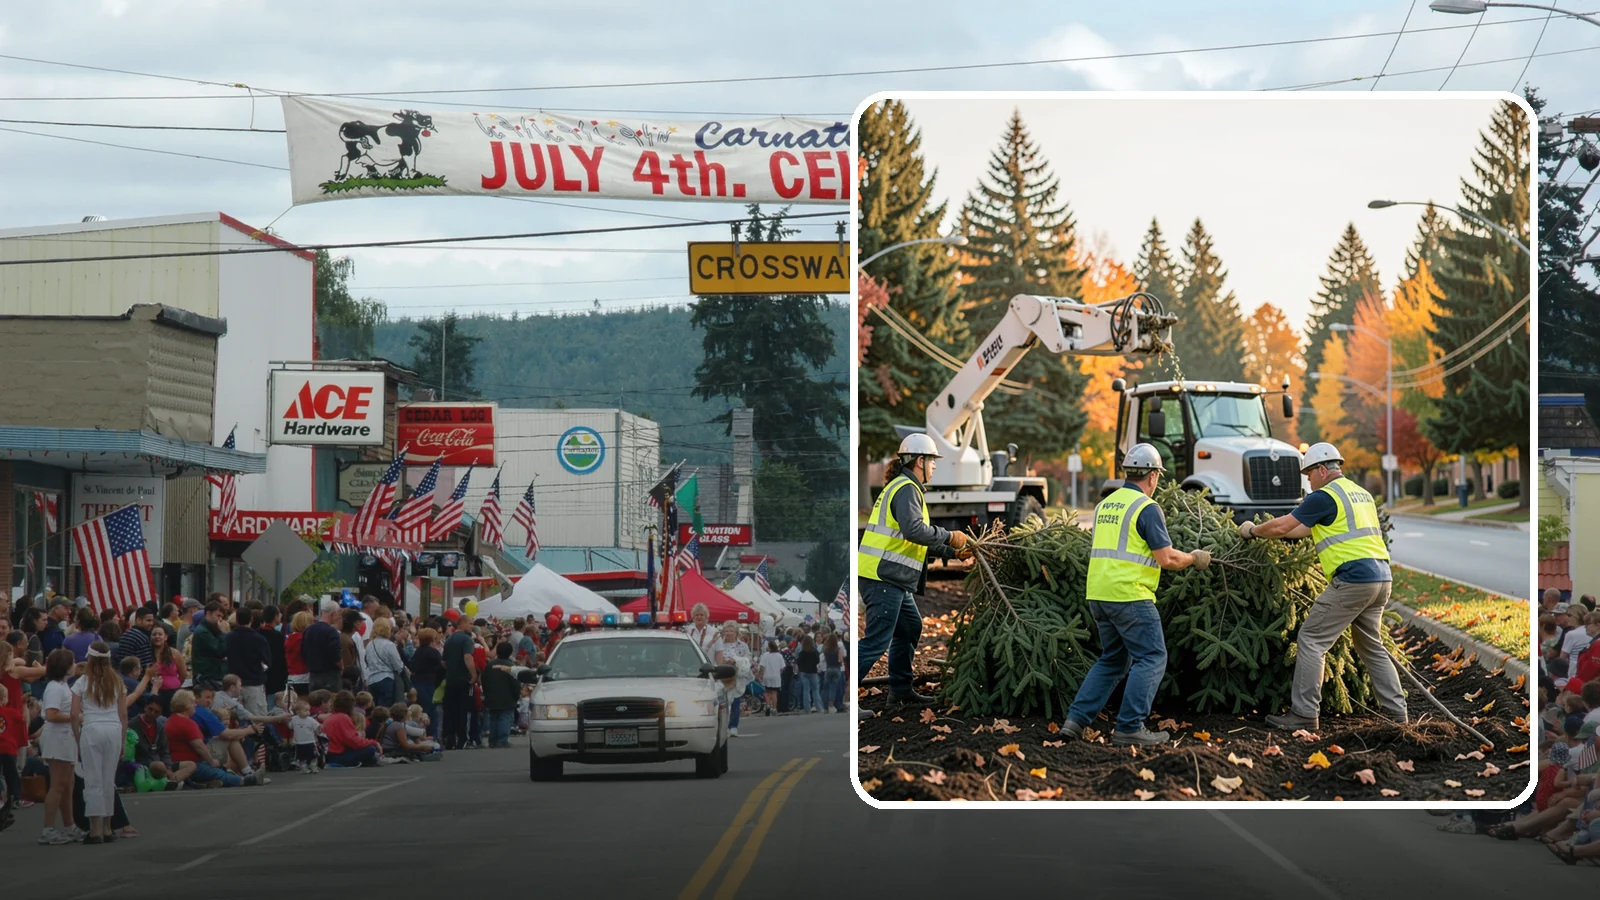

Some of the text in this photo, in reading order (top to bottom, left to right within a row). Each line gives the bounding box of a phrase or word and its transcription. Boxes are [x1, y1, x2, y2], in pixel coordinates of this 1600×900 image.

[695, 121, 850, 150] Carnat
[481, 141, 605, 192] JULY
[632, 150, 746, 198] 4th.
[697, 254, 850, 280] CROSSWA
[283, 380, 374, 420] ACE
[405, 409, 485, 422] CEDAR LOG
[283, 421, 371, 437] Hardware
[95, 485, 124, 495] Vincent
[126, 486, 136, 495] de
[137, 486, 155, 495] Paul
[688, 526, 741, 535] CRNATION
[699, 535, 730, 543] GLASS
